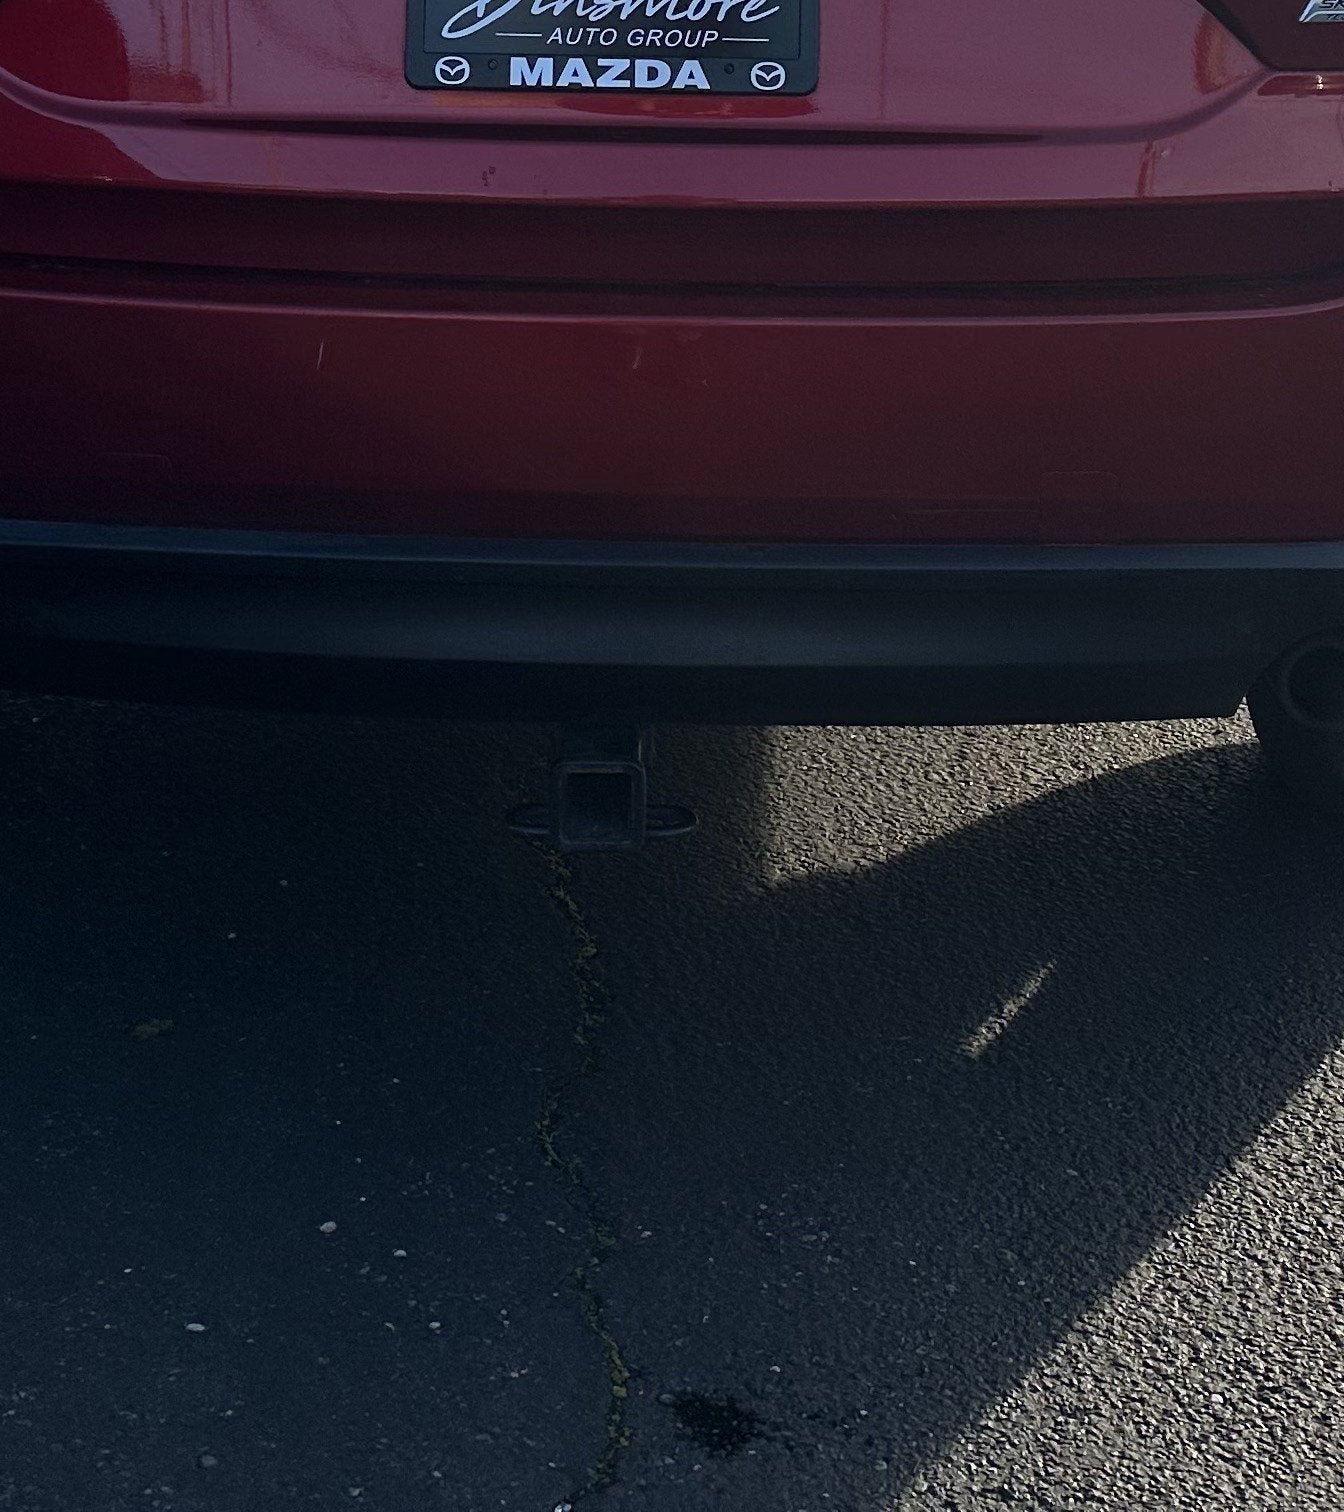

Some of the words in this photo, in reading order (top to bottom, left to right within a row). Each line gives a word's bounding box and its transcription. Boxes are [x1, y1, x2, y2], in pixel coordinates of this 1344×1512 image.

[547, 27, 618, 47] AUTO
[626, 28, 720, 48] GROUP
[509, 56, 711, 90] MAZDA
